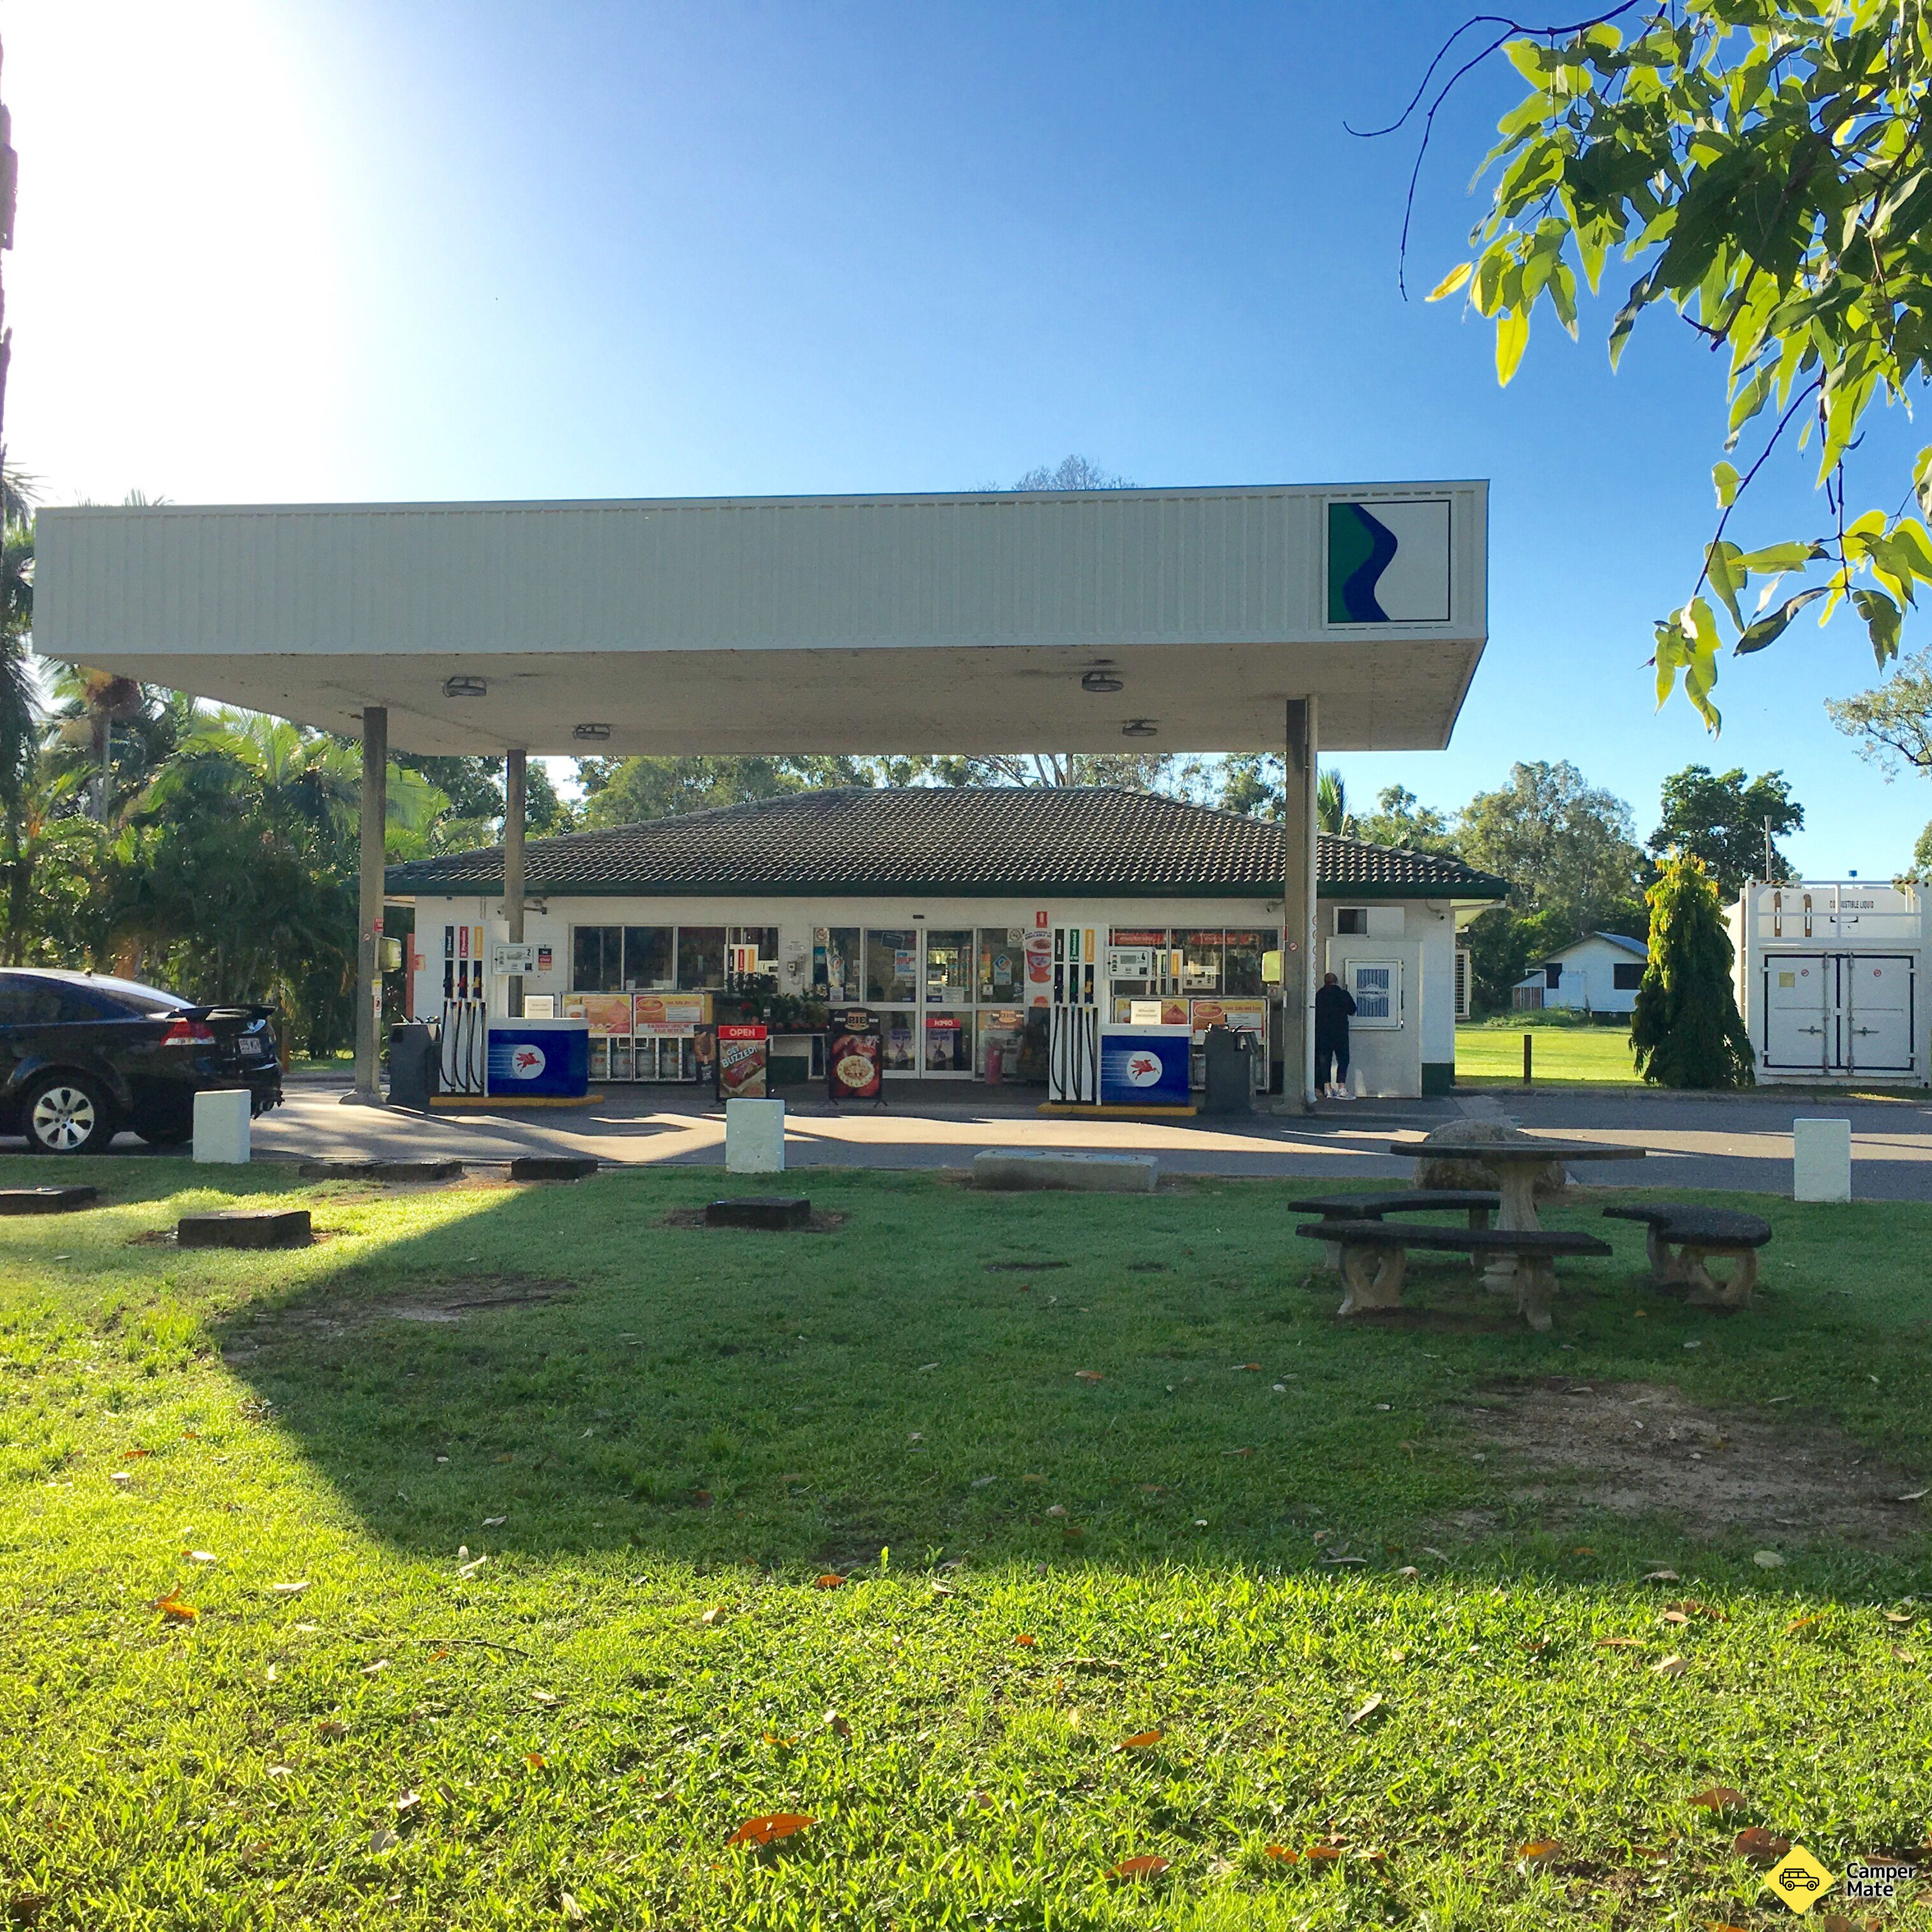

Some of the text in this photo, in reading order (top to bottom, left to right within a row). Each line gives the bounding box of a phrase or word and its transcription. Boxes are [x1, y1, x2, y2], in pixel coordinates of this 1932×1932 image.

[1829, 900, 1874, 909] COUSTIBLE LIQUID
[527, 948, 531, 957] 2
[1141, 952, 1146, 961] 4
[848, 1016, 867, 1025] PIE
[729, 1028, 755, 1037] OPEN
[726, 1046, 740, 1056] GET
[721, 1046, 758, 1068] BUZZED!
